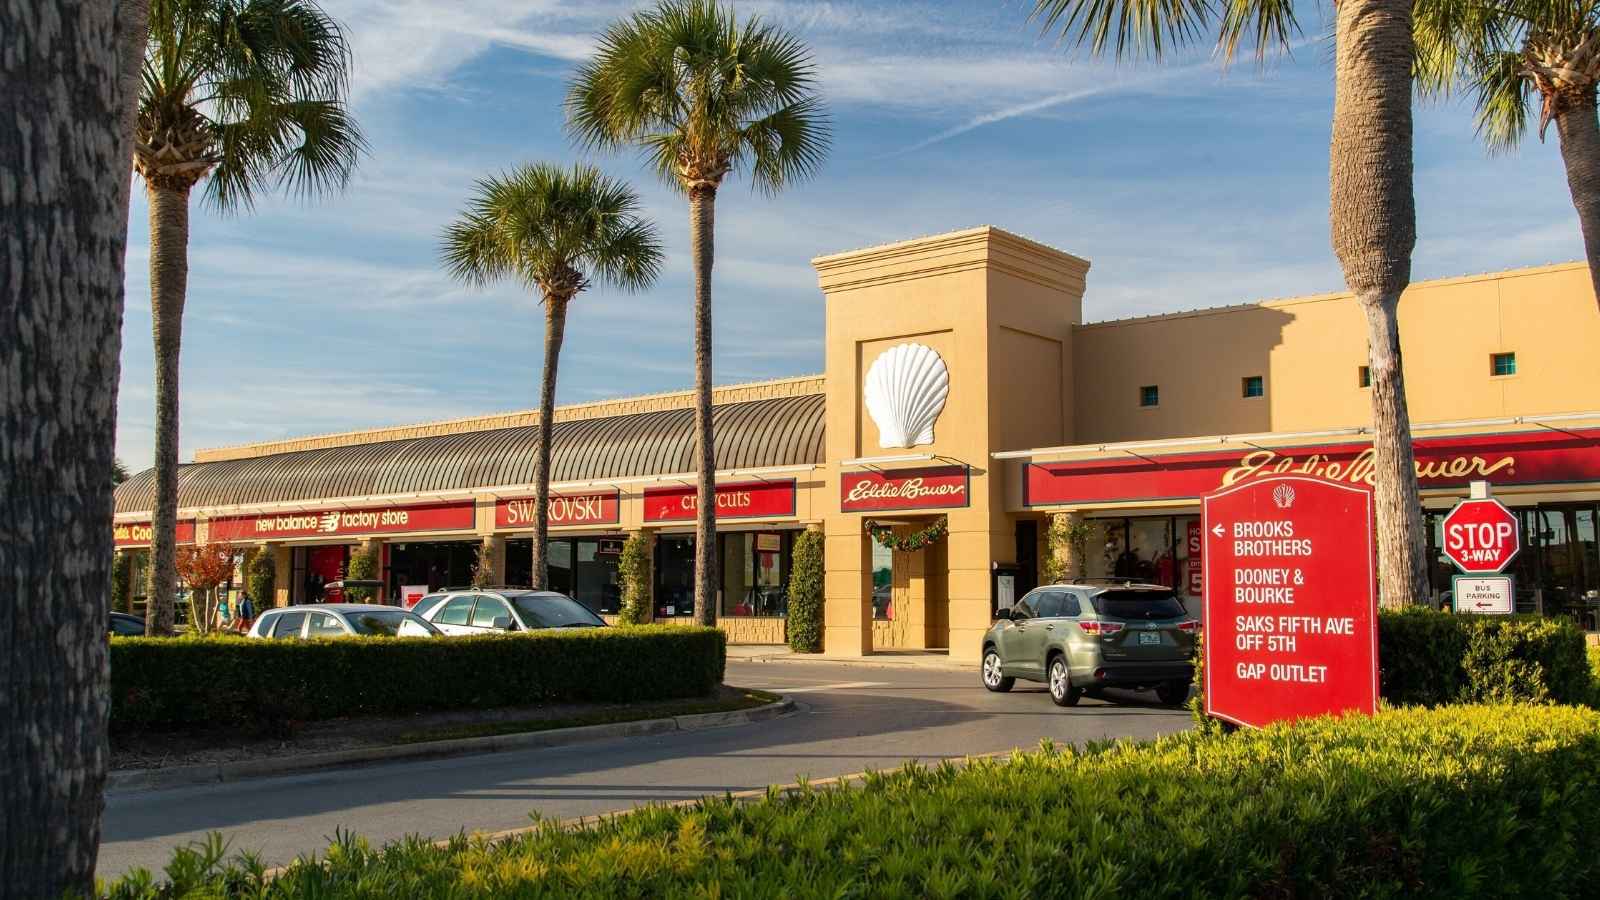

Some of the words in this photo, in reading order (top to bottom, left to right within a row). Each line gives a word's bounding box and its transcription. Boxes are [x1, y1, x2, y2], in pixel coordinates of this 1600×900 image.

[1218, 451, 1341, 488] Eddie
[844, 480, 898, 503] Eddie
[899, 477, 965, 499] Bauer
[507, 496, 603, 524] SWROVSKI
[681, 491, 751, 510] crcuts
[255, 518, 275, 532] new
[276, 516, 318, 531] balance
[342, 511, 380, 529] factory
[381, 509, 408, 525] store
[1233, 521, 1294, 538] BROOKS
[131, 525, 153, 541] Coo
[1449, 522, 1512, 549] STOP
[1234, 539, 1312, 557] BROTHERS
[1461, 550, 1501, 562] 3-WAY
[1235, 568, 1290, 585] DOONEY
[1293, 568, 1304, 585] &
[1235, 587, 1295, 604] BOURKE
[1466, 592, 1501, 600] PARKING
[1236, 615, 1274, 633] SAKS
[1279, 616, 1321, 634] FIFTH
[1324, 617, 1354, 635] AVE
[1236, 633, 1264, 651] OFF
[1268, 635, 1296, 652] 5TH
[1236, 662, 1266, 680] GAP
[1270, 664, 1327, 683] OUTLET
